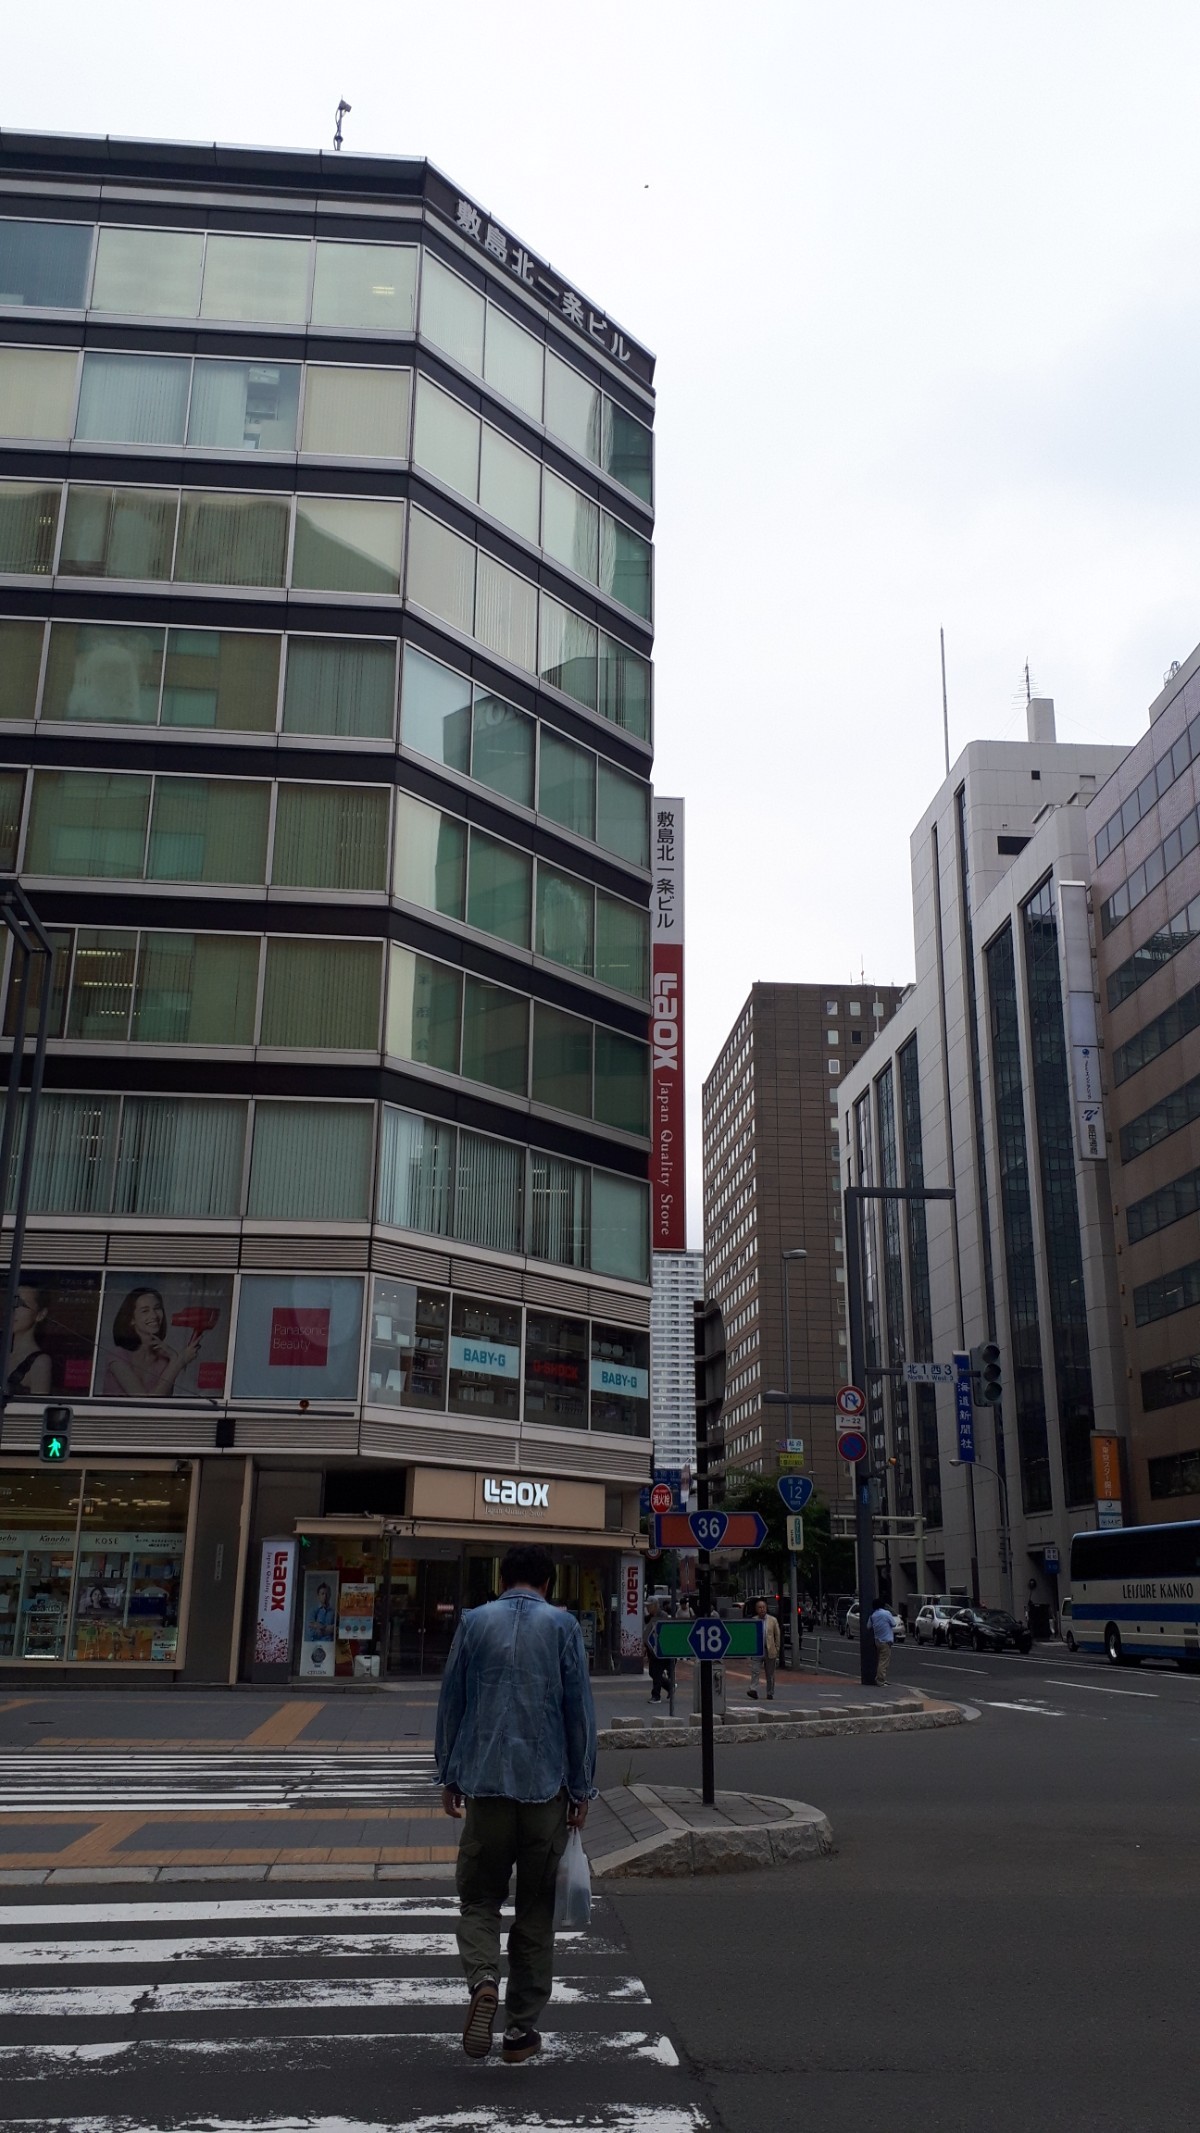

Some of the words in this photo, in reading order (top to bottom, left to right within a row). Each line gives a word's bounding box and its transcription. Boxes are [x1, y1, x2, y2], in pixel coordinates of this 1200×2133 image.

[457, 198, 630, 361] 敷島北一条ビル
[656, 811, 675, 929] 敷島北一条ビル
[657, 1080, 673, 1123] Japan
[657, 1129, 673, 1187] Quality
[659, 1194, 673, 1236] Store
[273, 1324, 327, 1336] Panasonic
[272, 1339, 311, 1352] Beauty
[463, 1348, 506, 1367] BABY-G
[533, 1360, 578, 1379] G-SHOCK
[601, 1371, 637, 1389] BABY-G
[957, 1367, 973, 1449] 海道新聞社
[653, 1494, 670, 1506] 消火栓
[790, 1486, 802, 1499] 12
[698, 1517, 720, 1539] 36
[39, 1534, 70, 1543] Kanebo
[1122, 1583, 1157, 1599] LEISURE
[1160, 1582, 1194, 1599] KANKO
[696, 1626, 722, 1653] 18
